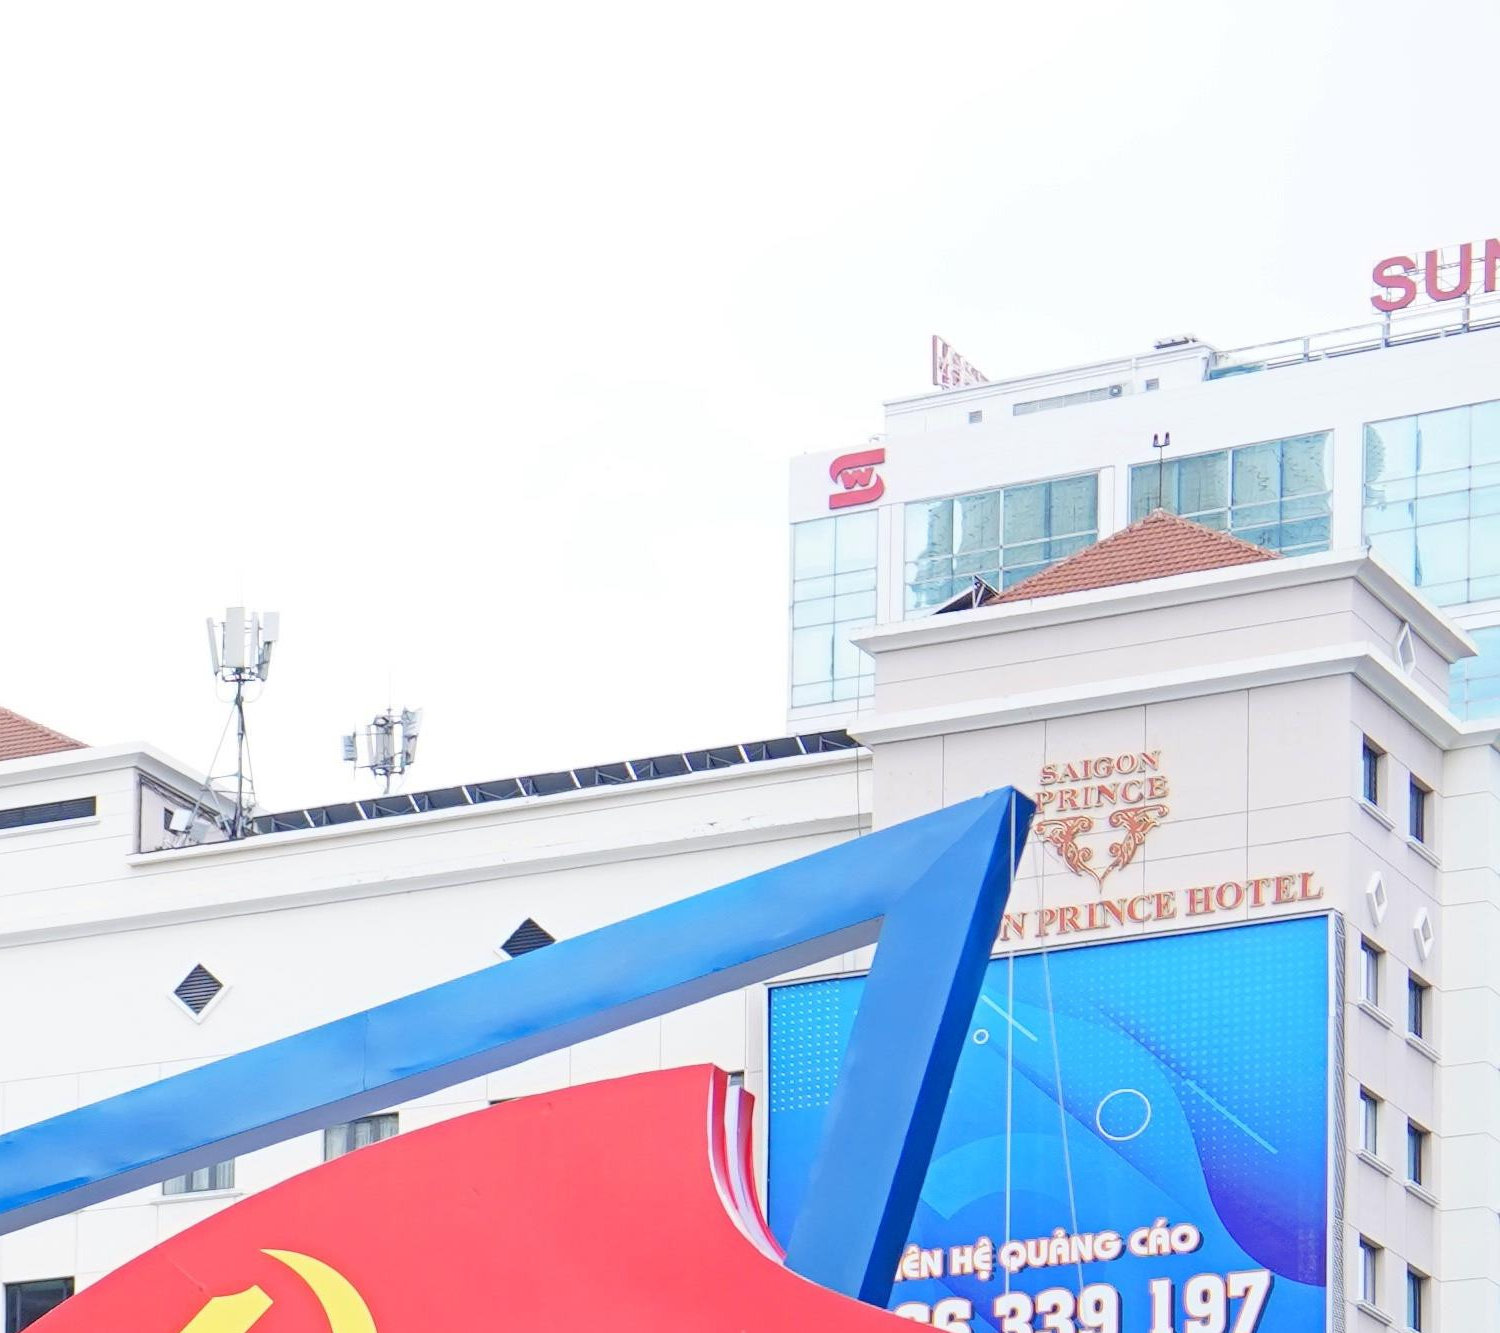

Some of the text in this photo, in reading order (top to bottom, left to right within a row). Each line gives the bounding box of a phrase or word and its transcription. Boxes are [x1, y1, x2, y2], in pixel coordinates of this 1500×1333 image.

[1040, 751, 1161, 785] SAIGON
[1035, 776, 1169, 814] PRINCE
[1035, 891, 1176, 938] PRINCE
[1186, 871, 1324, 916] HOTEL
[949, 1235, 995, 1281] HỆ
[1000, 1227, 1123, 1272] QUẢNG
[1129, 1217, 1200, 1257] CÁO
